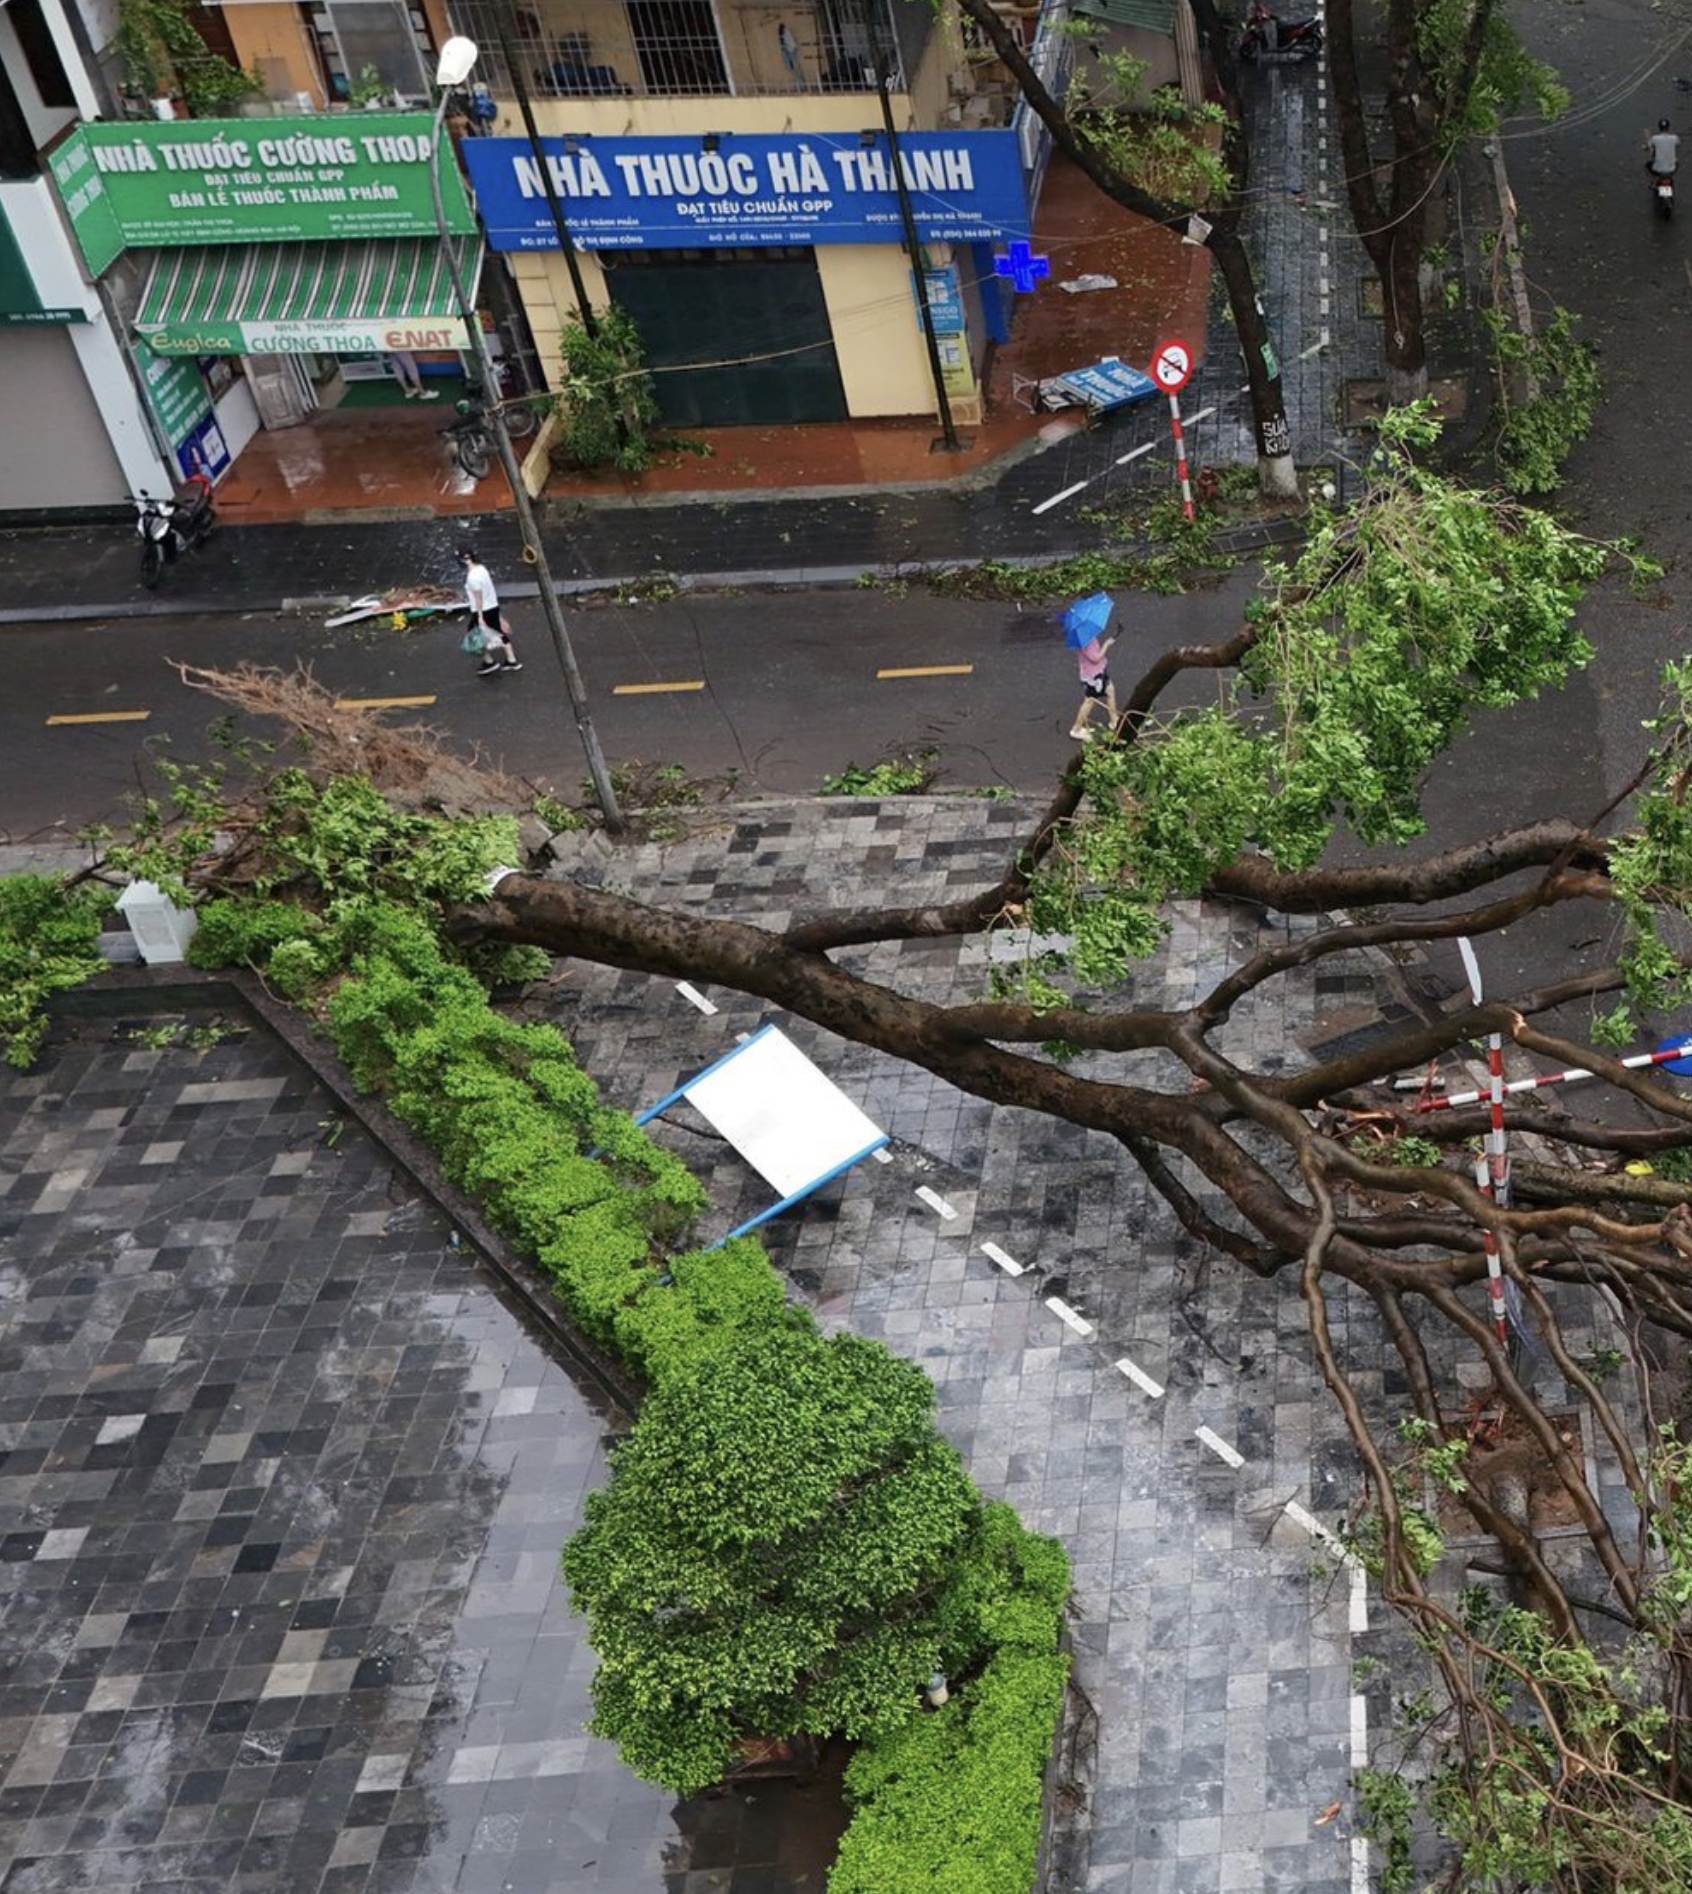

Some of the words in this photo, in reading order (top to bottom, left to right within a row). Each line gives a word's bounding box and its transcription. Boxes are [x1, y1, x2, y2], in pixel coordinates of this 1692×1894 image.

[93, 138, 157, 172] NHÀ
[158, 131, 252, 170] THUỐC
[258, 131, 358, 167] CƯỜNG
[318, 169, 345, 182] GPP
[512, 147, 612, 198] NHÀ
[767, 144, 830, 194] HÀ
[833, 148, 974, 193] THANH
[169, 189, 206, 208] BÁN
[232, 185, 286, 206] THUỐC
[289, 185, 347, 203] THÀNH
[676, 201, 706, 217] ĐẠT
[709, 199, 740, 214] TIÊU
[743, 196, 799, 214] CHUẨN
[802, 200, 833, 212] GPP
[152, 332, 232, 353] Eugica
[324, 334, 377, 350] THOA
